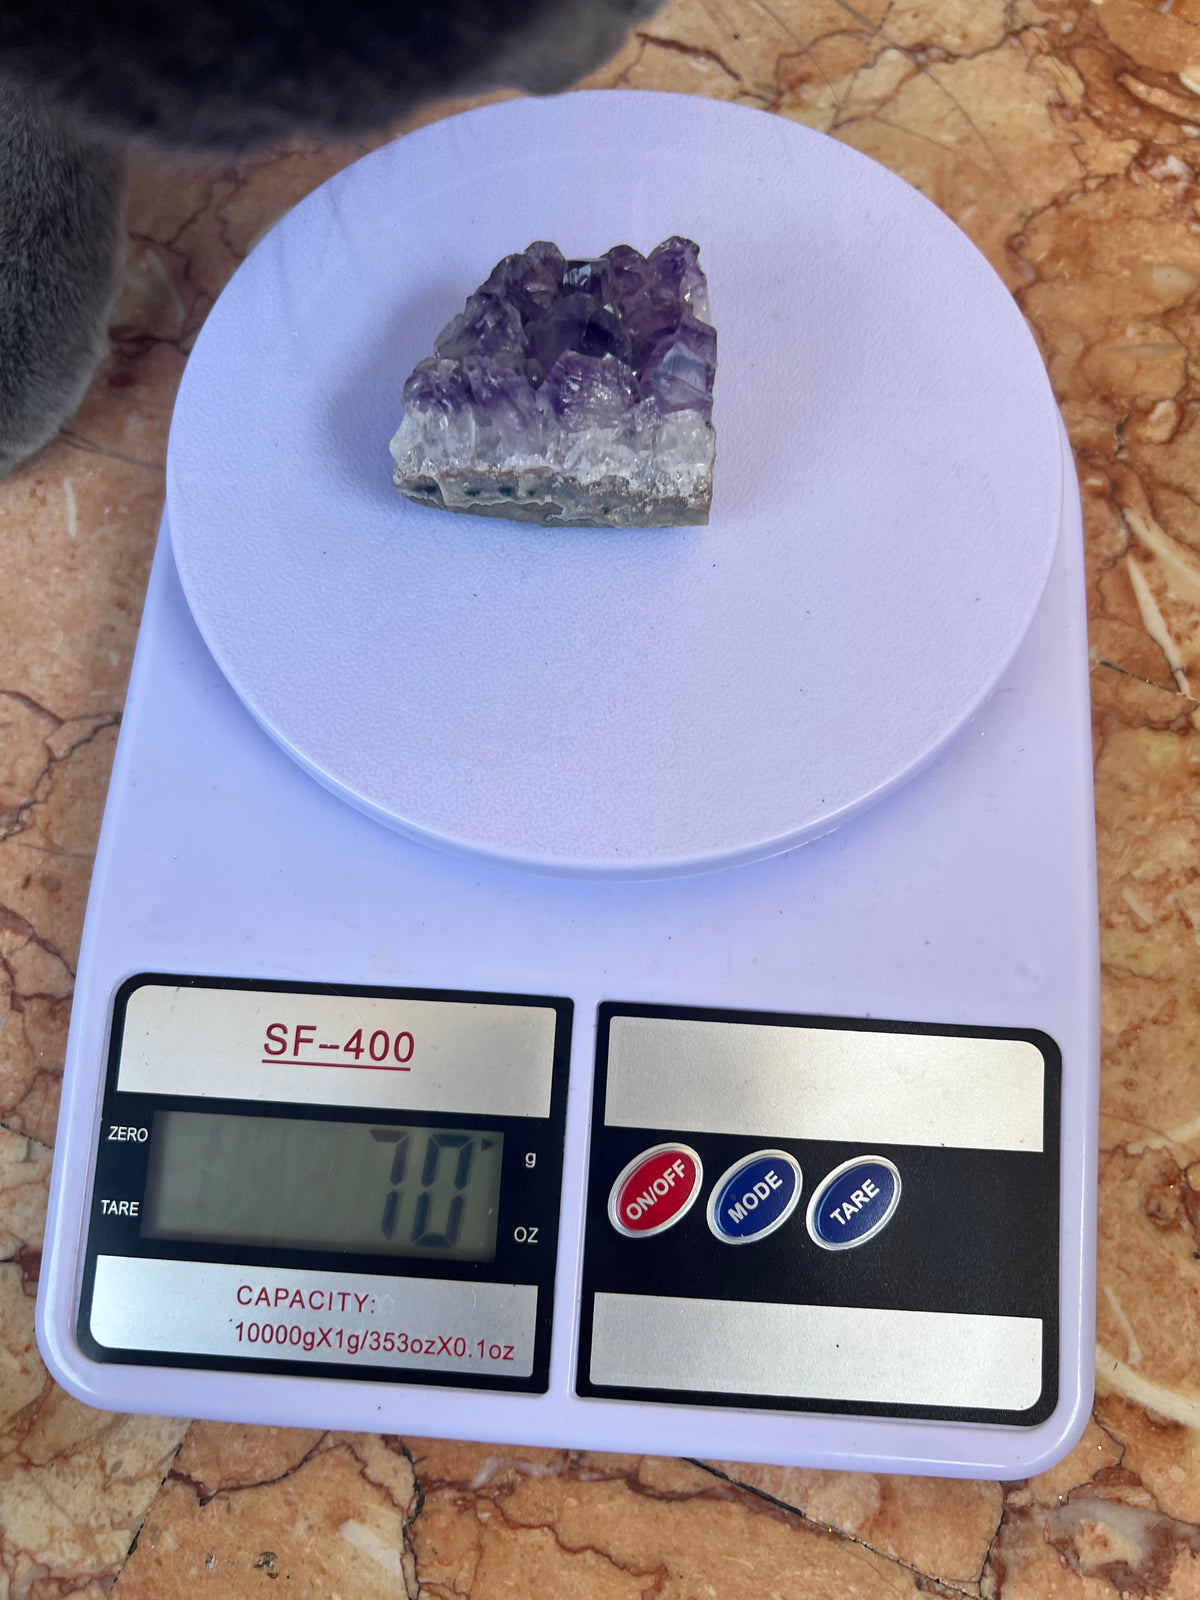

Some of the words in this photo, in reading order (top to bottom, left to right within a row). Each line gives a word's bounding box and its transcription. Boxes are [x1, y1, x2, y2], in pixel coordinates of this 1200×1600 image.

[263, 1022, 416, 1064] SF-400
[108, 1125, 149, 1143] ZERO
[525, 1151, 537, 1169] g
[101, 1199, 140, 1217] TARE
[368, 1128, 475, 1250] 70
[625, 1158, 687, 1222] ON/OFF
[727, 1169, 783, 1224] MODE
[829, 1178, 880, 1227] TARE
[236, 1284, 377, 1315] CAPACITY:
[234, 1321, 516, 1361] 10000gX1g/353ozX0.1oz
